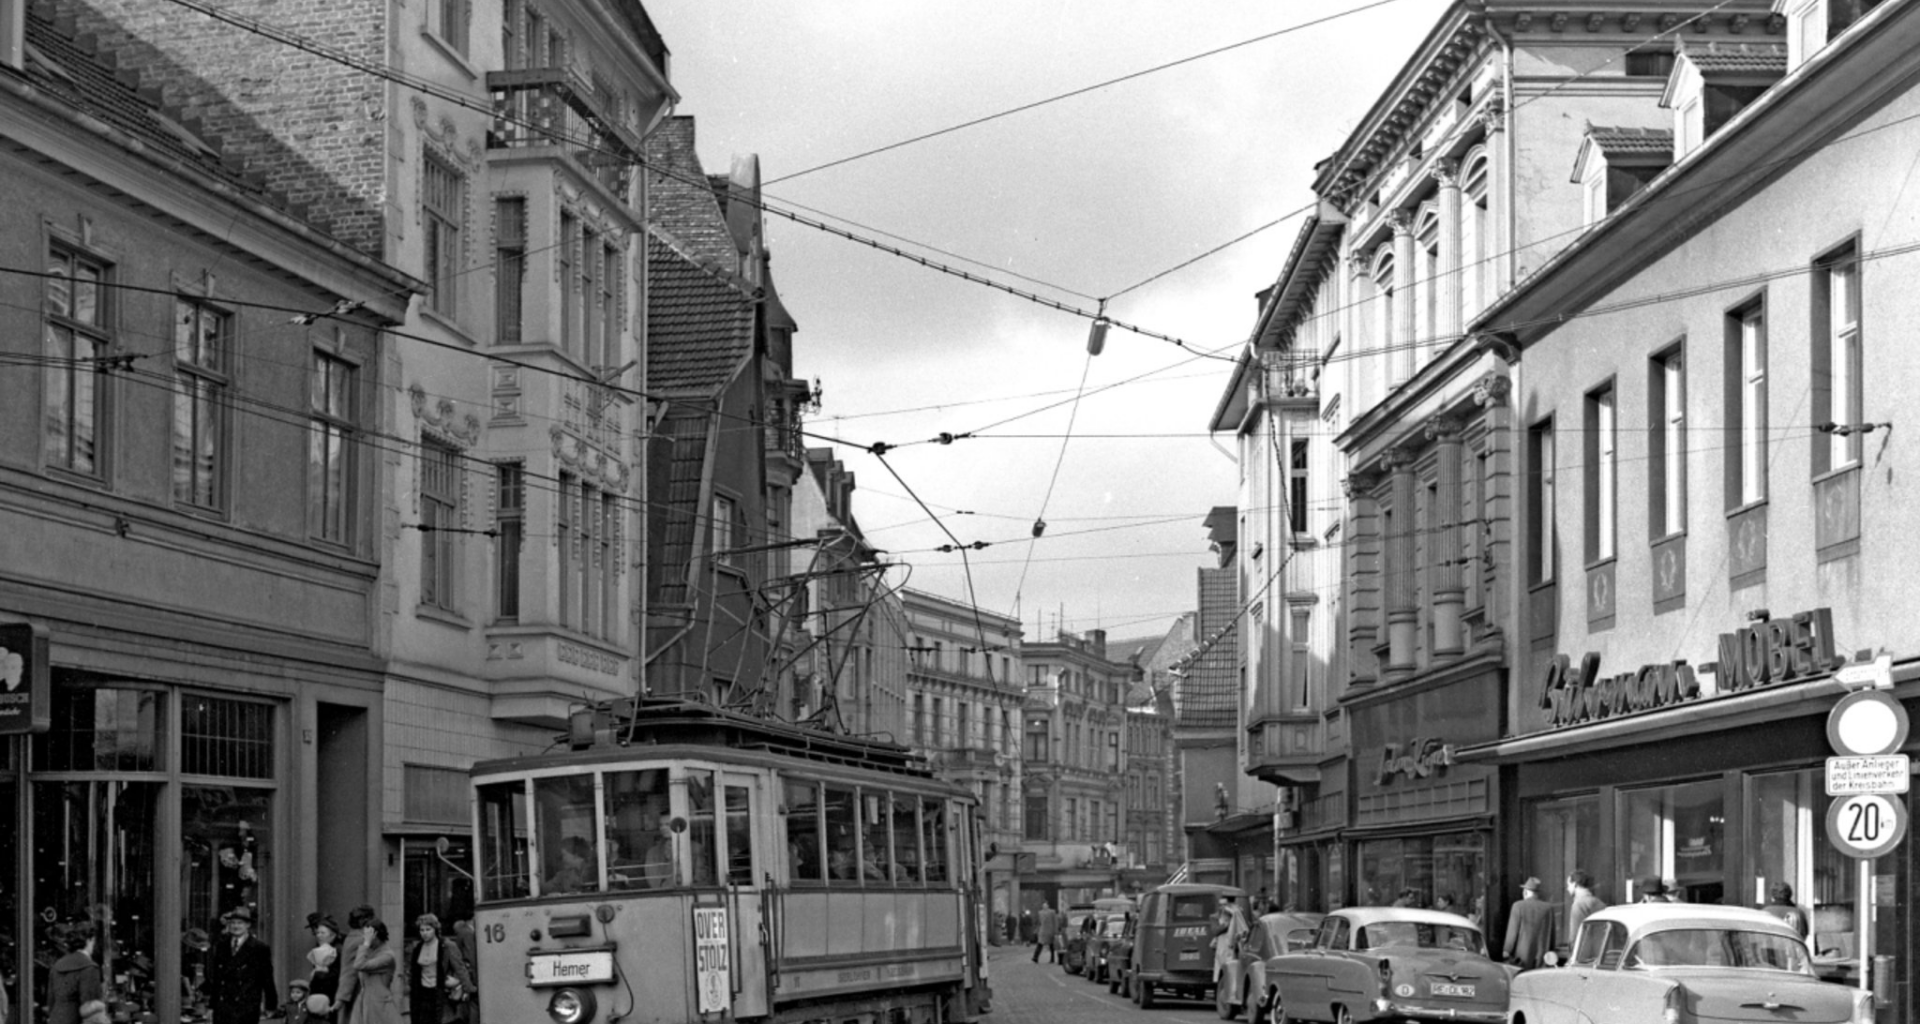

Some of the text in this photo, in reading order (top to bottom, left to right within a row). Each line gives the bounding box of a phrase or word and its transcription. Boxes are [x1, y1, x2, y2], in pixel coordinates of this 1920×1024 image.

[1834, 759, 1899, 771] Außer Anlieger
[1831, 770, 1904, 781] und Linienverkehr
[1832, 780, 1895, 791] der Kreisbahn
[1848, 803, 1880, 841] 20
[484, 923, 506, 943] 16
[697, 912, 726, 939] OVER
[698, 944, 727, 972] STOLZ
[552, 960, 590, 978] Hemer
